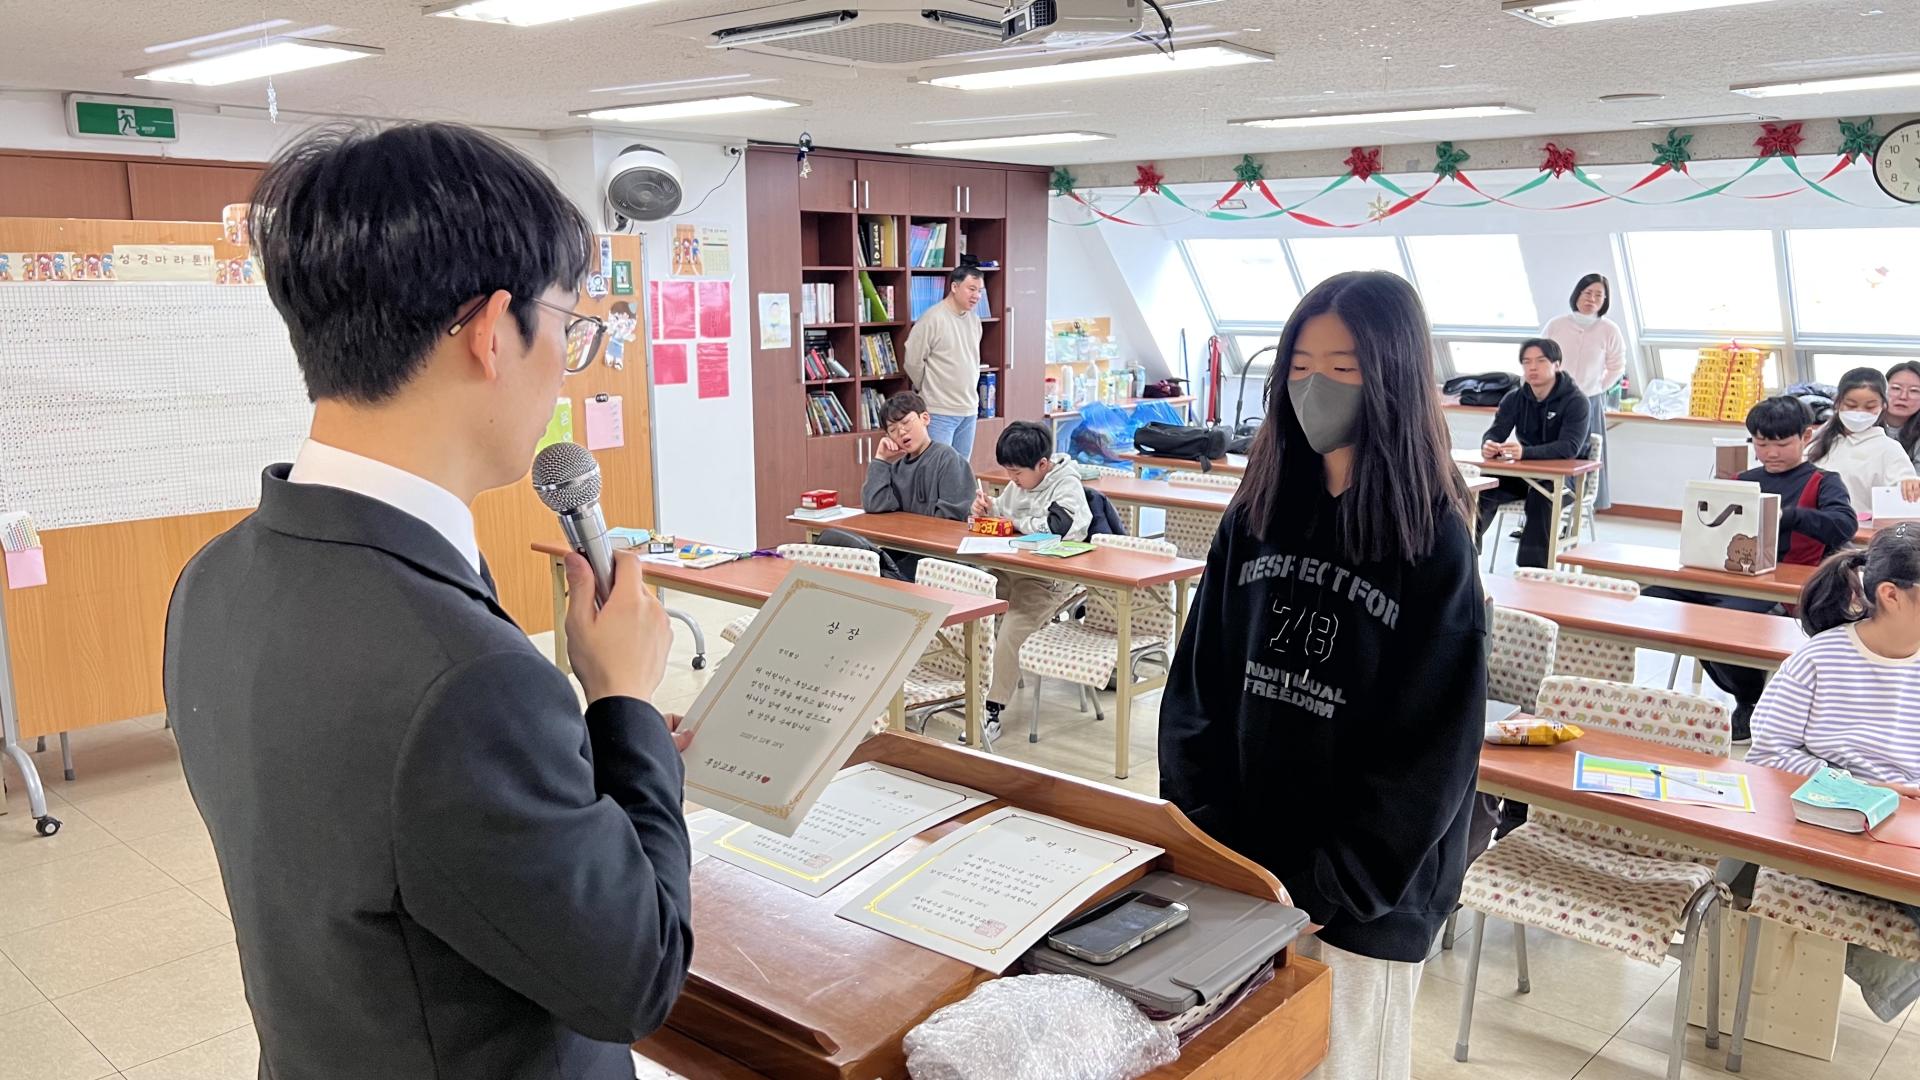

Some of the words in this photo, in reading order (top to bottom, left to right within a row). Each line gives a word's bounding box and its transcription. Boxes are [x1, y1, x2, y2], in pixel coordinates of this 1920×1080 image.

[1902, 134, 1909, 143] 11
[1890, 145, 1900, 154] 10
[1885, 159, 1892, 168] 9
[1891, 173, 1898, 182] 8
[1903, 182, 1910, 191] 7
